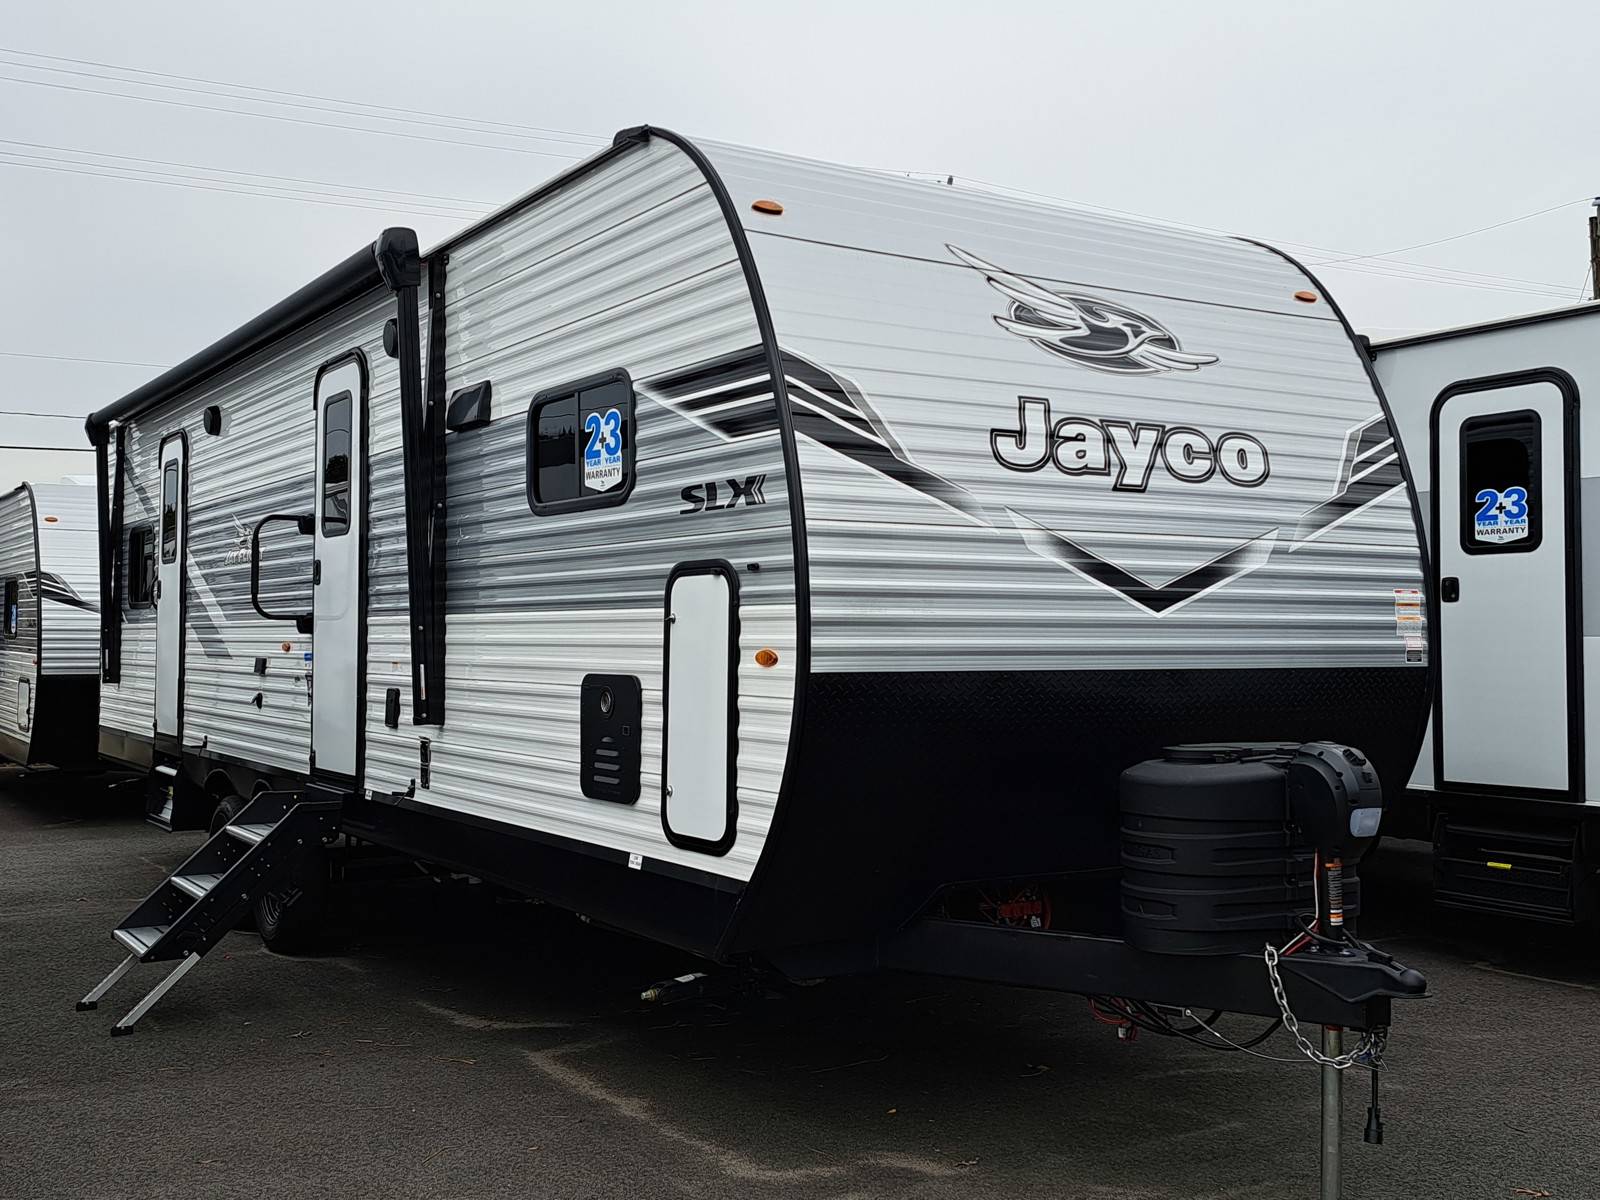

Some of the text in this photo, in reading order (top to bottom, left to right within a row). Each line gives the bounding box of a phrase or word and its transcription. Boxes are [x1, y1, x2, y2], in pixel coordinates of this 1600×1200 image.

[990, 396, 1270, 493] Jayco
[586, 456, 620, 468] YEAR YEAR
[586, 468, 620, 480] WARRANTY
[680, 474, 767, 514] SLX
[1477, 527, 1526, 536] WARRANTY
